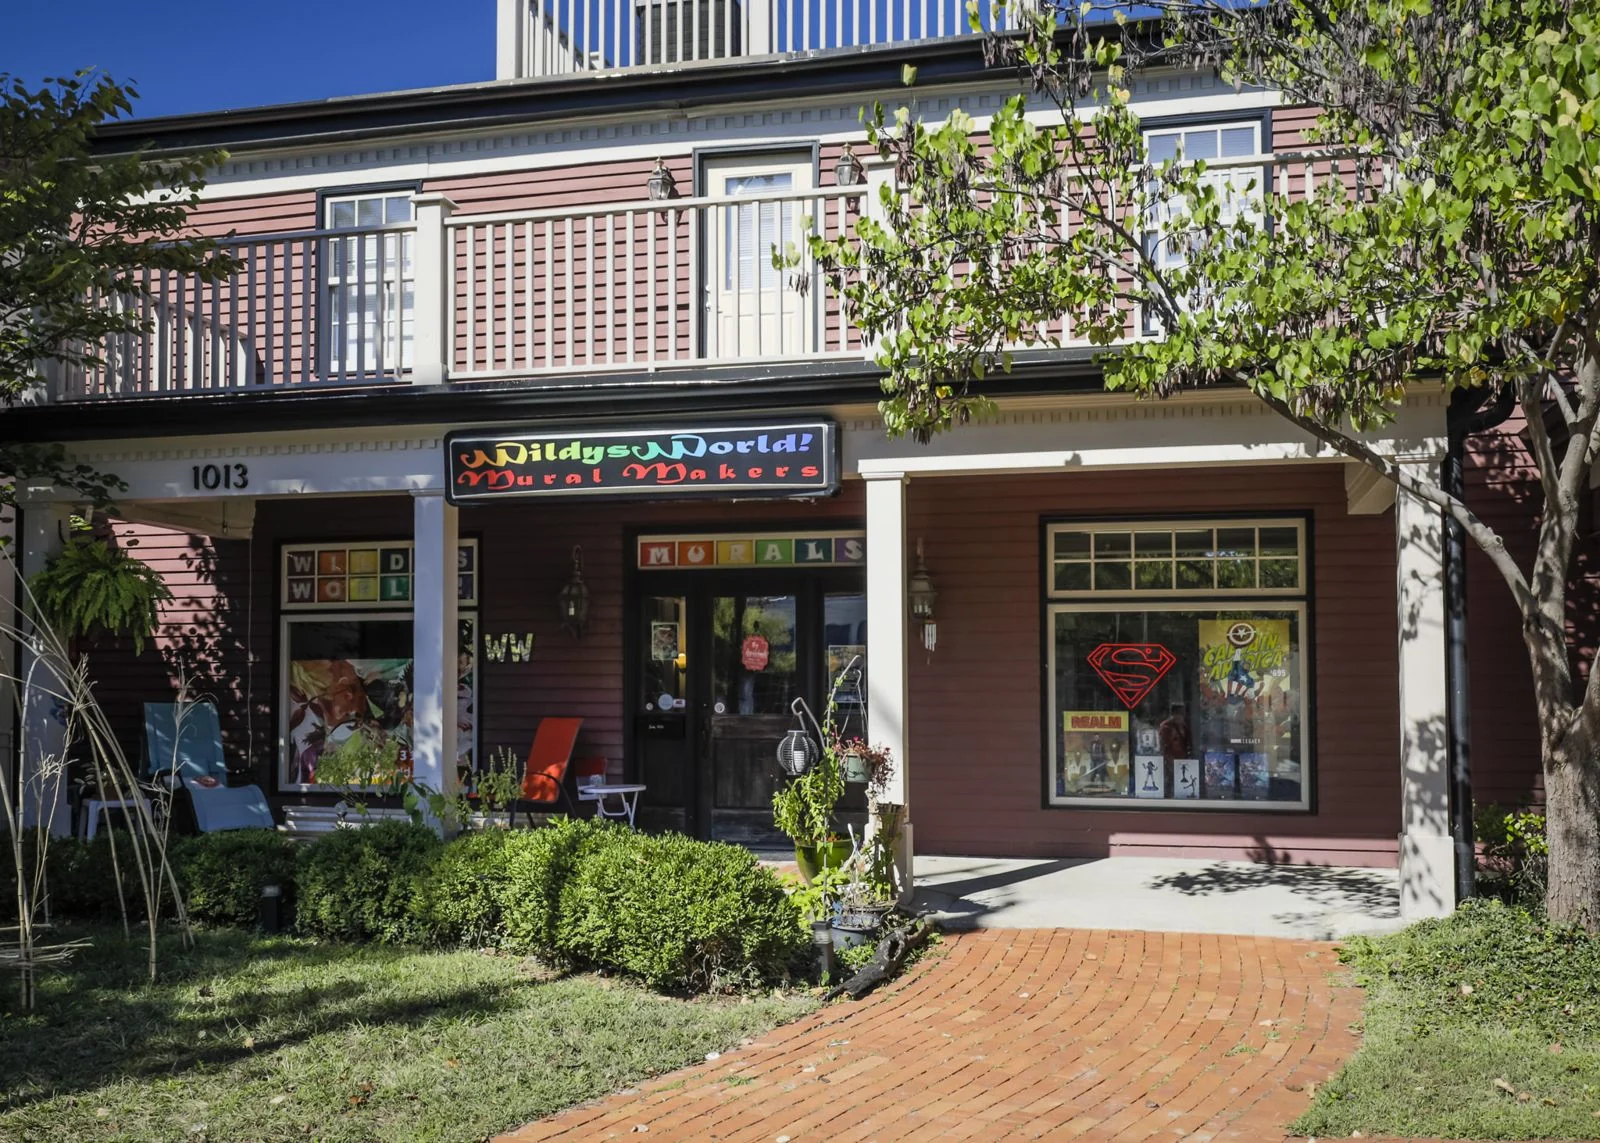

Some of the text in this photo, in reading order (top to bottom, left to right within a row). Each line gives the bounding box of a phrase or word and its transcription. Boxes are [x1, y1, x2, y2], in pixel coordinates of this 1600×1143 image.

[192, 463, 249, 490] 1013
[457, 461, 820, 491] Mural Makers
[647, 538, 864, 565] MURALS
[1071, 715, 1122, 729] REALM
